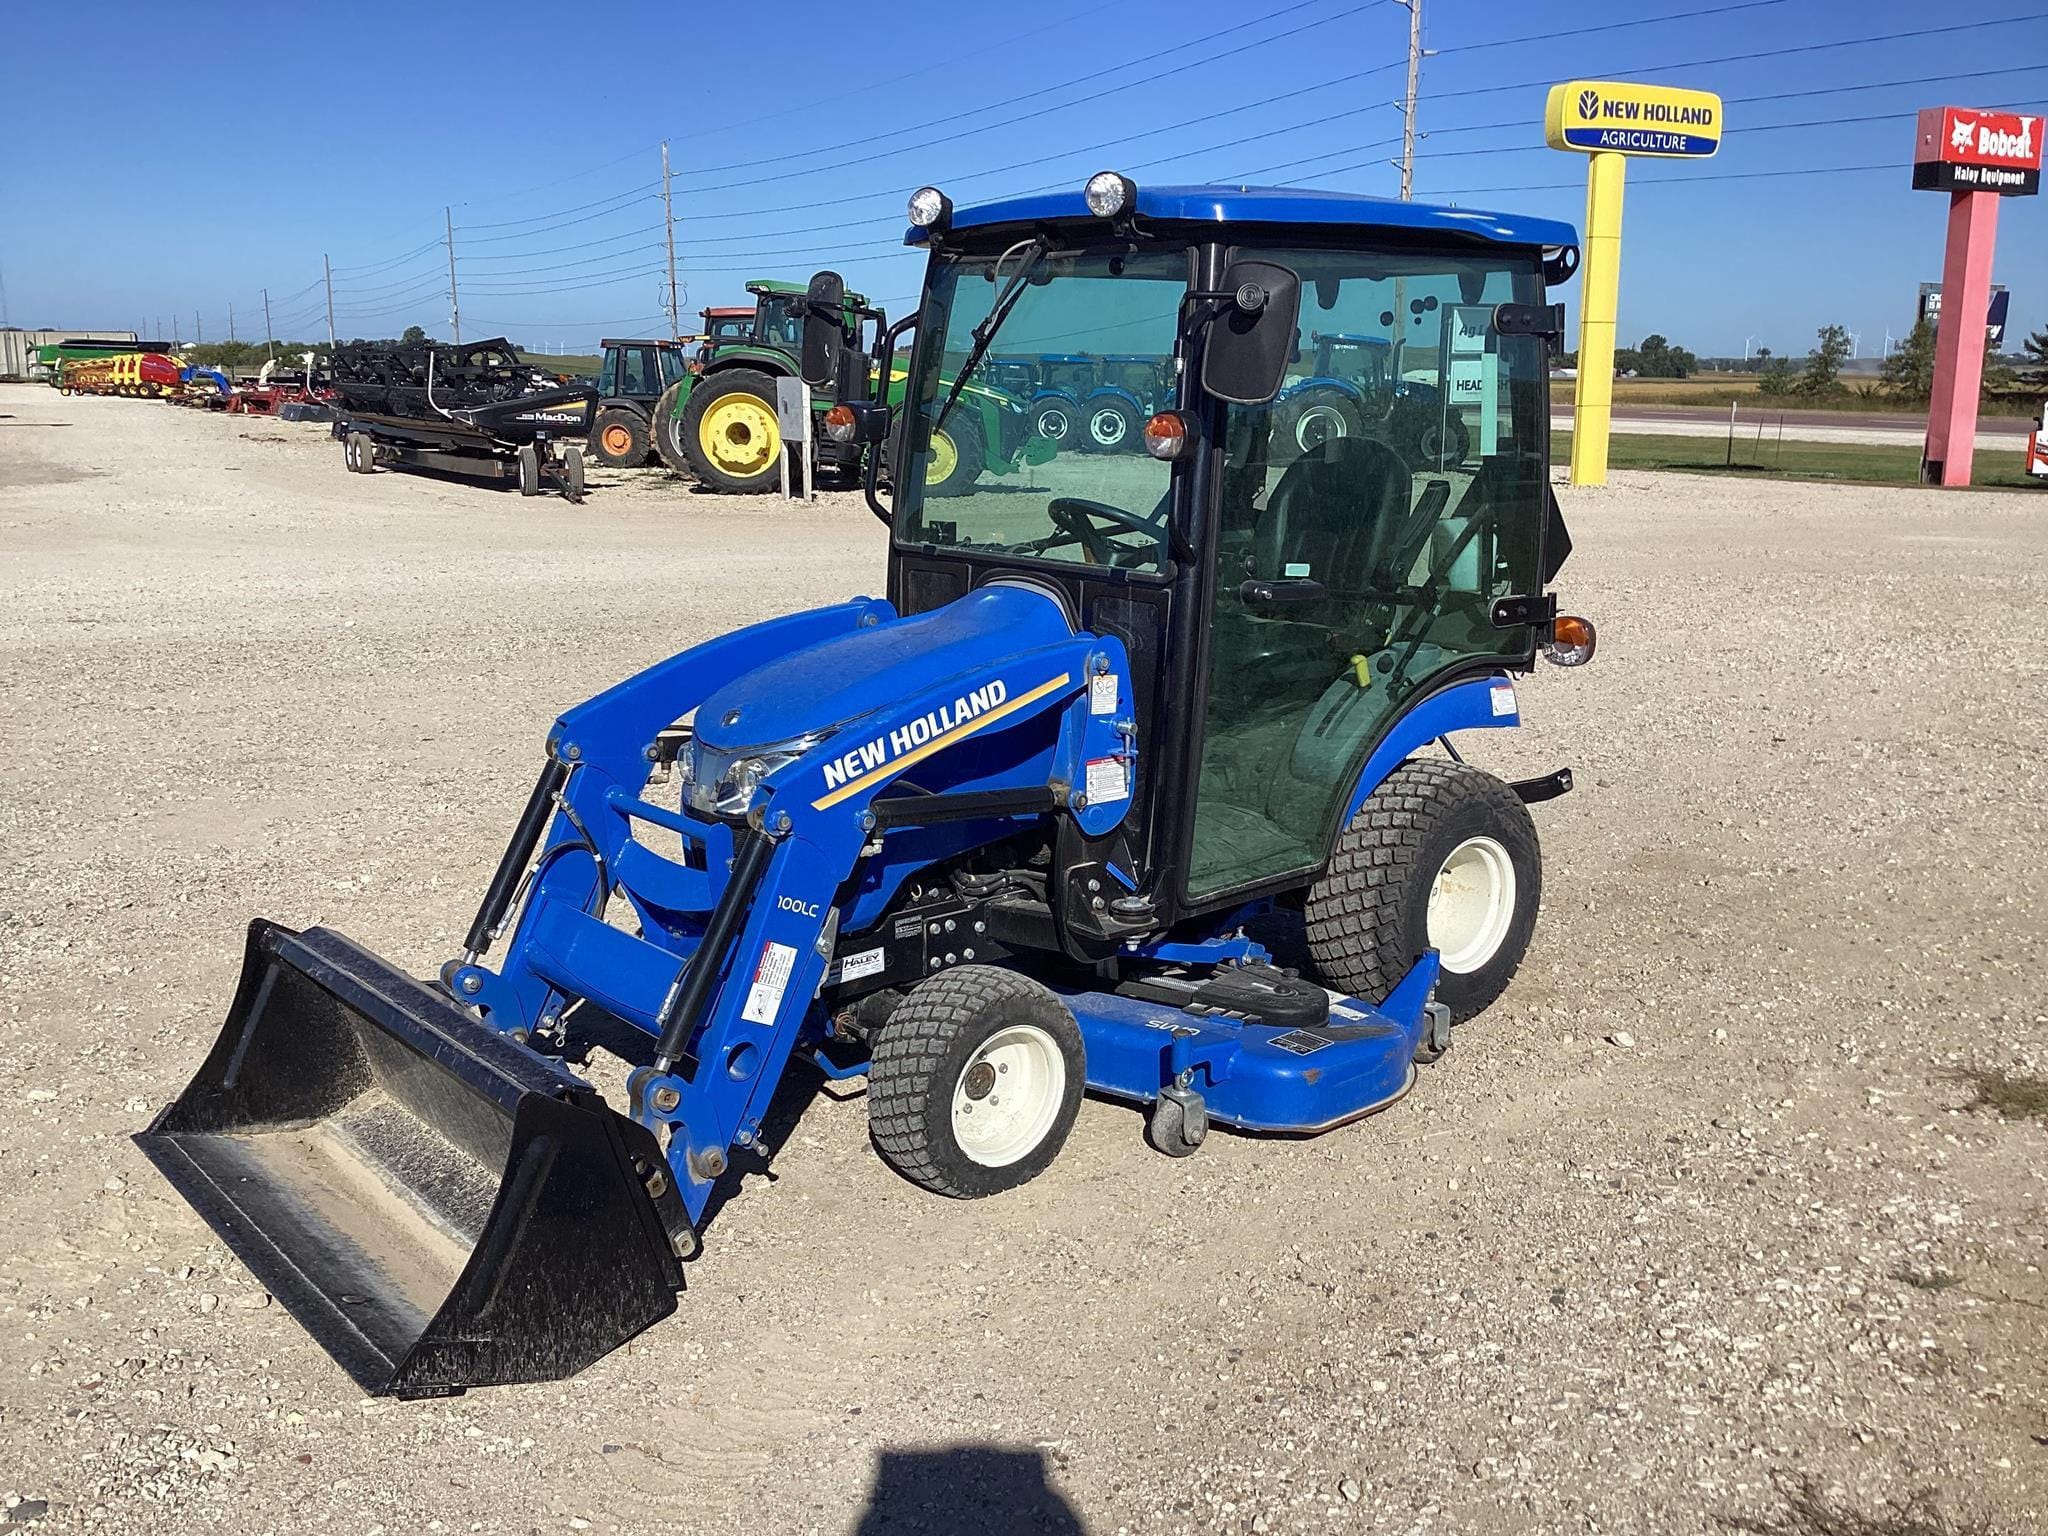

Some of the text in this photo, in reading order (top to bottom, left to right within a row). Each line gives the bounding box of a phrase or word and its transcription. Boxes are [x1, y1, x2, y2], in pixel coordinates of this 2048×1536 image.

[1603, 100, 1713, 126] NEW HOLLAND
[1600, 130, 1687, 150] AGRICULTURE
[1978, 117, 2033, 158] Bobcat
[1954, 166, 2026, 187] Haley Equipment
[535, 412, 582, 422] MacDon
[822, 679, 1008, 791] NEW HOLLAND
[777, 894, 820, 919] 100LC
